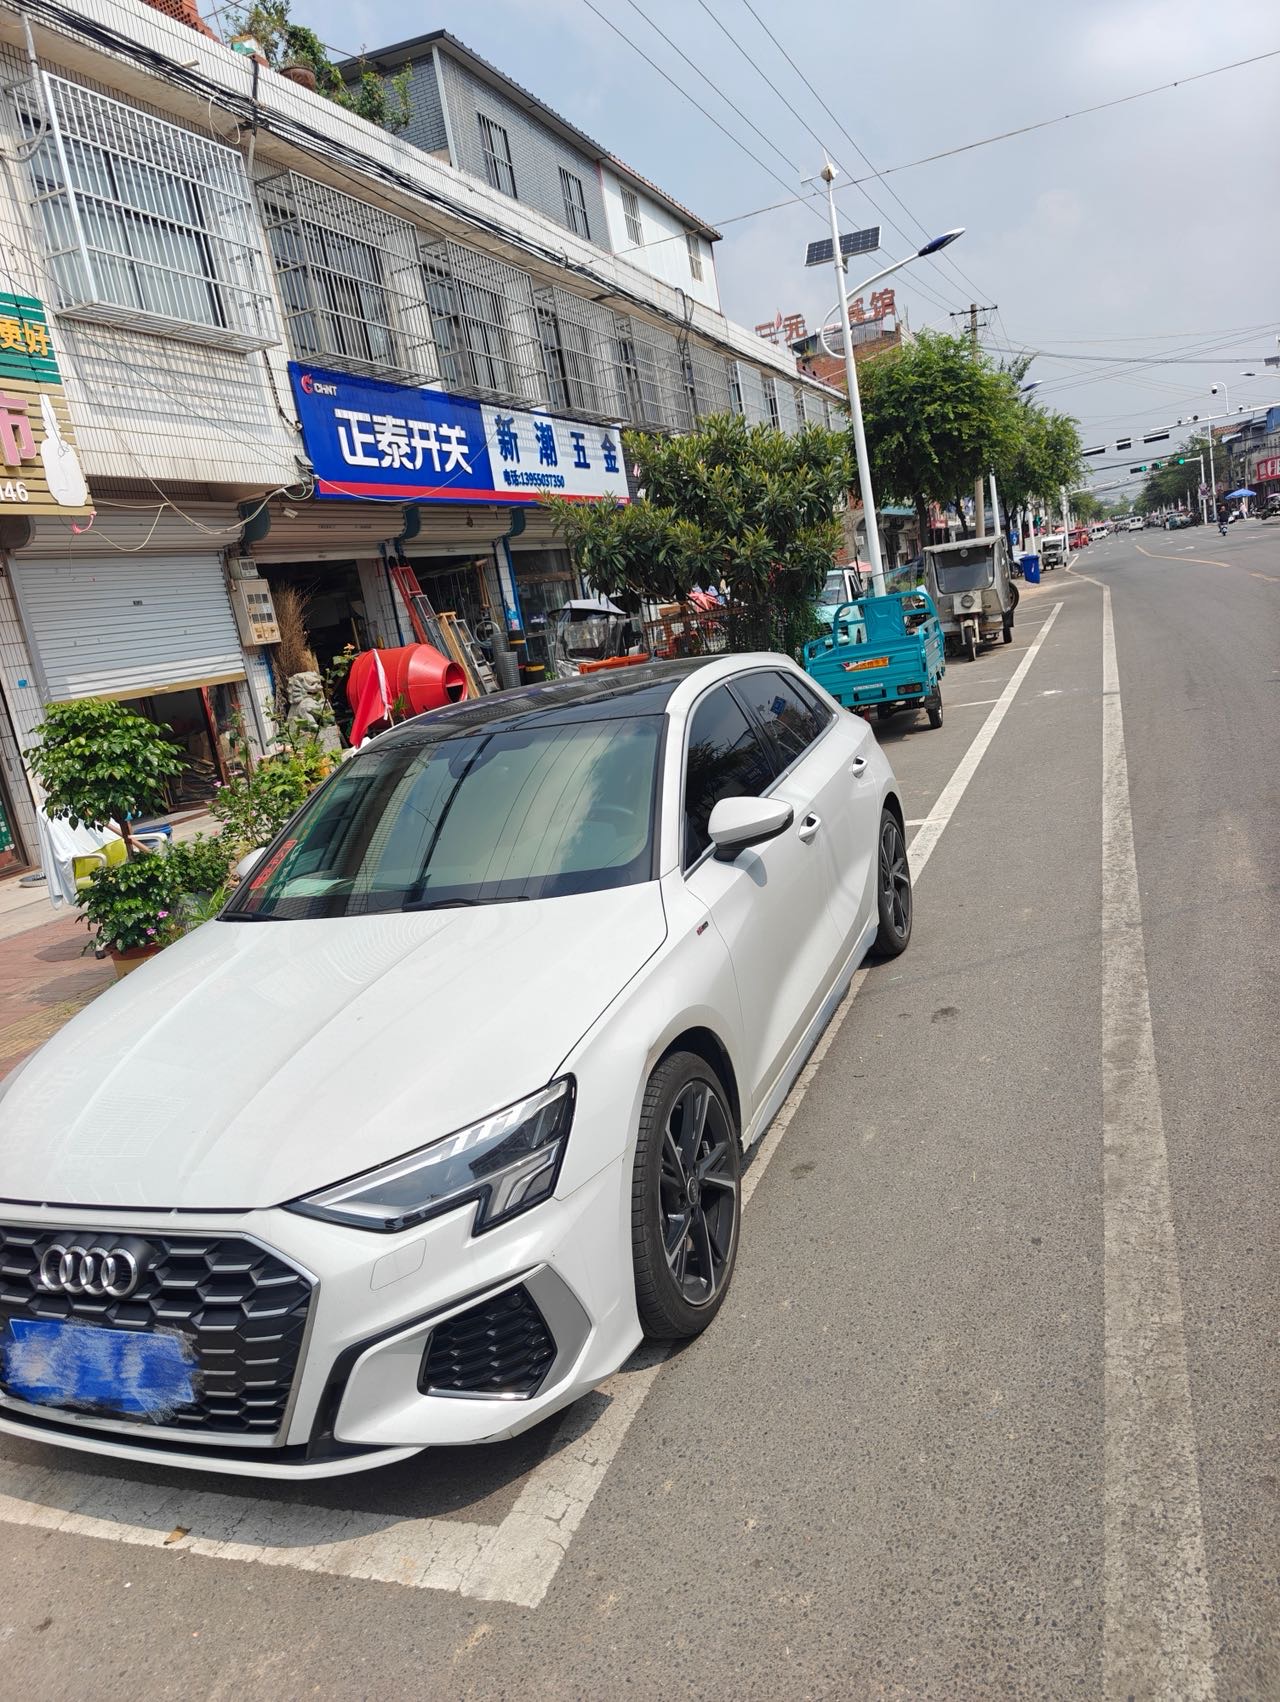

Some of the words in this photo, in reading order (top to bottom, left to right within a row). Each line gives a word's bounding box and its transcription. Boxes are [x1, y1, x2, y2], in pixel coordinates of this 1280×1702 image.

[0, 318, 49, 357] 更好
[334, 408, 473, 475] 正泰开关
[494, 414, 619, 473] 新潮五金
